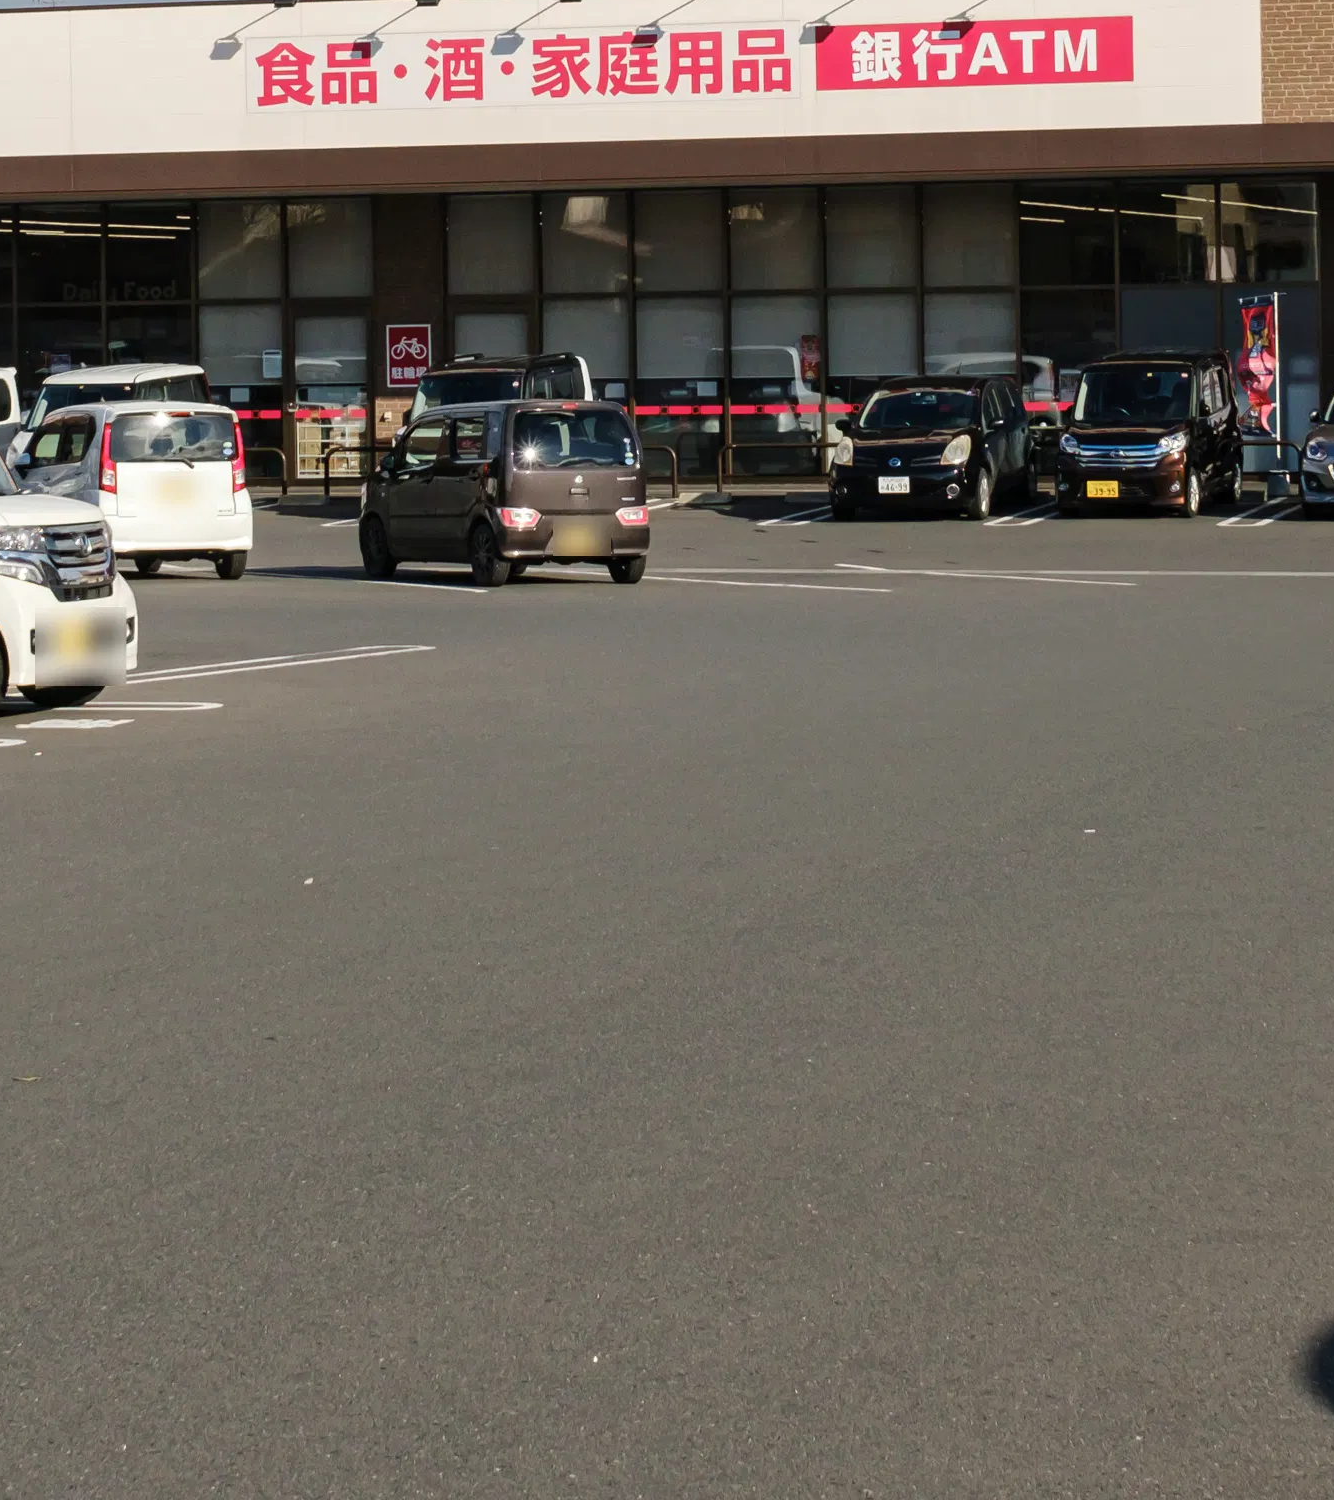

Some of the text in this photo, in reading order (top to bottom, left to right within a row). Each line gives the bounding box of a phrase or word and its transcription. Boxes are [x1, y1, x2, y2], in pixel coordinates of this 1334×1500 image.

[255, 29, 793, 107] 食品・酒・家庭用品
[850, 25, 1099, 84] 銀行ATM
